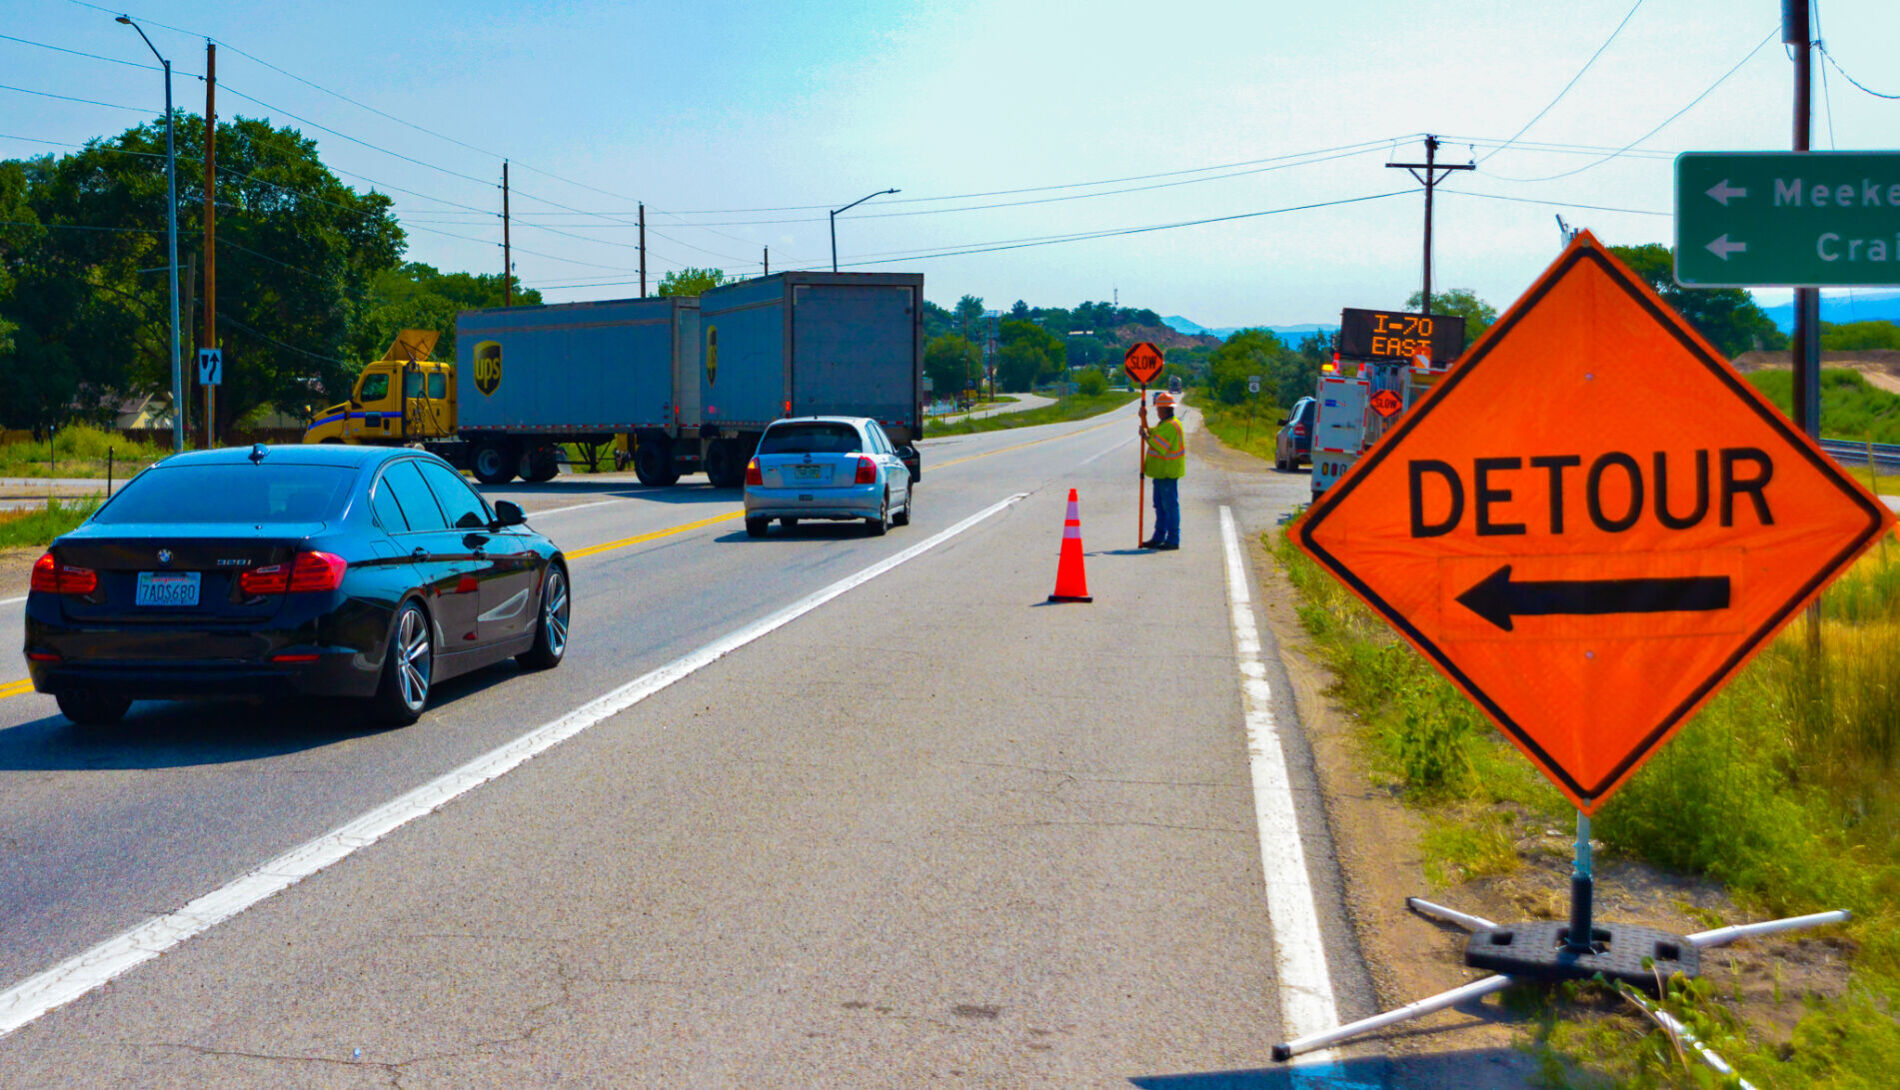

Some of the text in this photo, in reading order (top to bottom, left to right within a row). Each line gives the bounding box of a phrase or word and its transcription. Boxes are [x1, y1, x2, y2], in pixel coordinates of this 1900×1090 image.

[1373, 314, 1433, 337] I-70
[475, 357, 500, 389] ups
[1130, 355, 1157, 370] SLOW
[1375, 398, 1398, 409] SLOW
[1408, 446, 1775, 538] DETOUR
